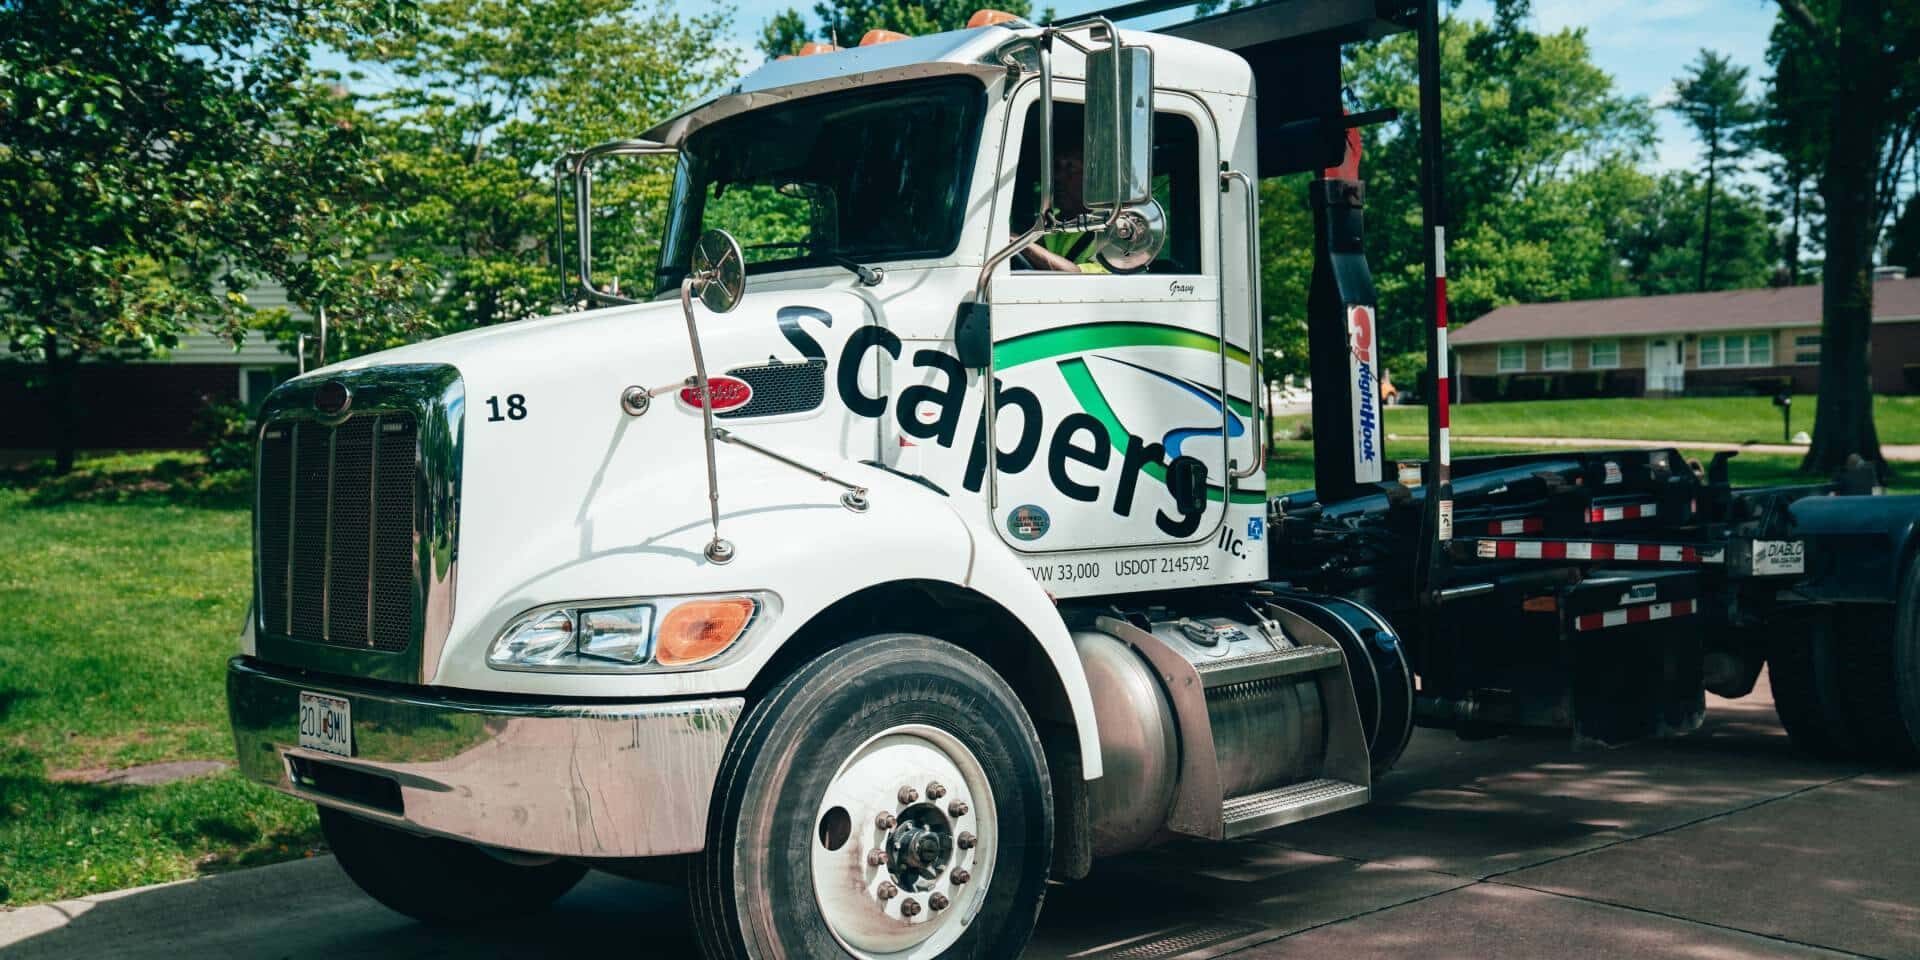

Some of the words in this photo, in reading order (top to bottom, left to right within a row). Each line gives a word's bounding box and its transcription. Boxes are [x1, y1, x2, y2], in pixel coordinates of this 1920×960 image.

[1169, 280, 1195, 297] Gravy
[486, 393, 528, 422] 18
[1358, 362, 1376, 462] RightHook
[1218, 525, 1246, 560] llc.
[1057, 562, 1100, 583] 33,000
[1115, 559, 1158, 576] USDOT
[1161, 555, 1210, 573] 2145792
